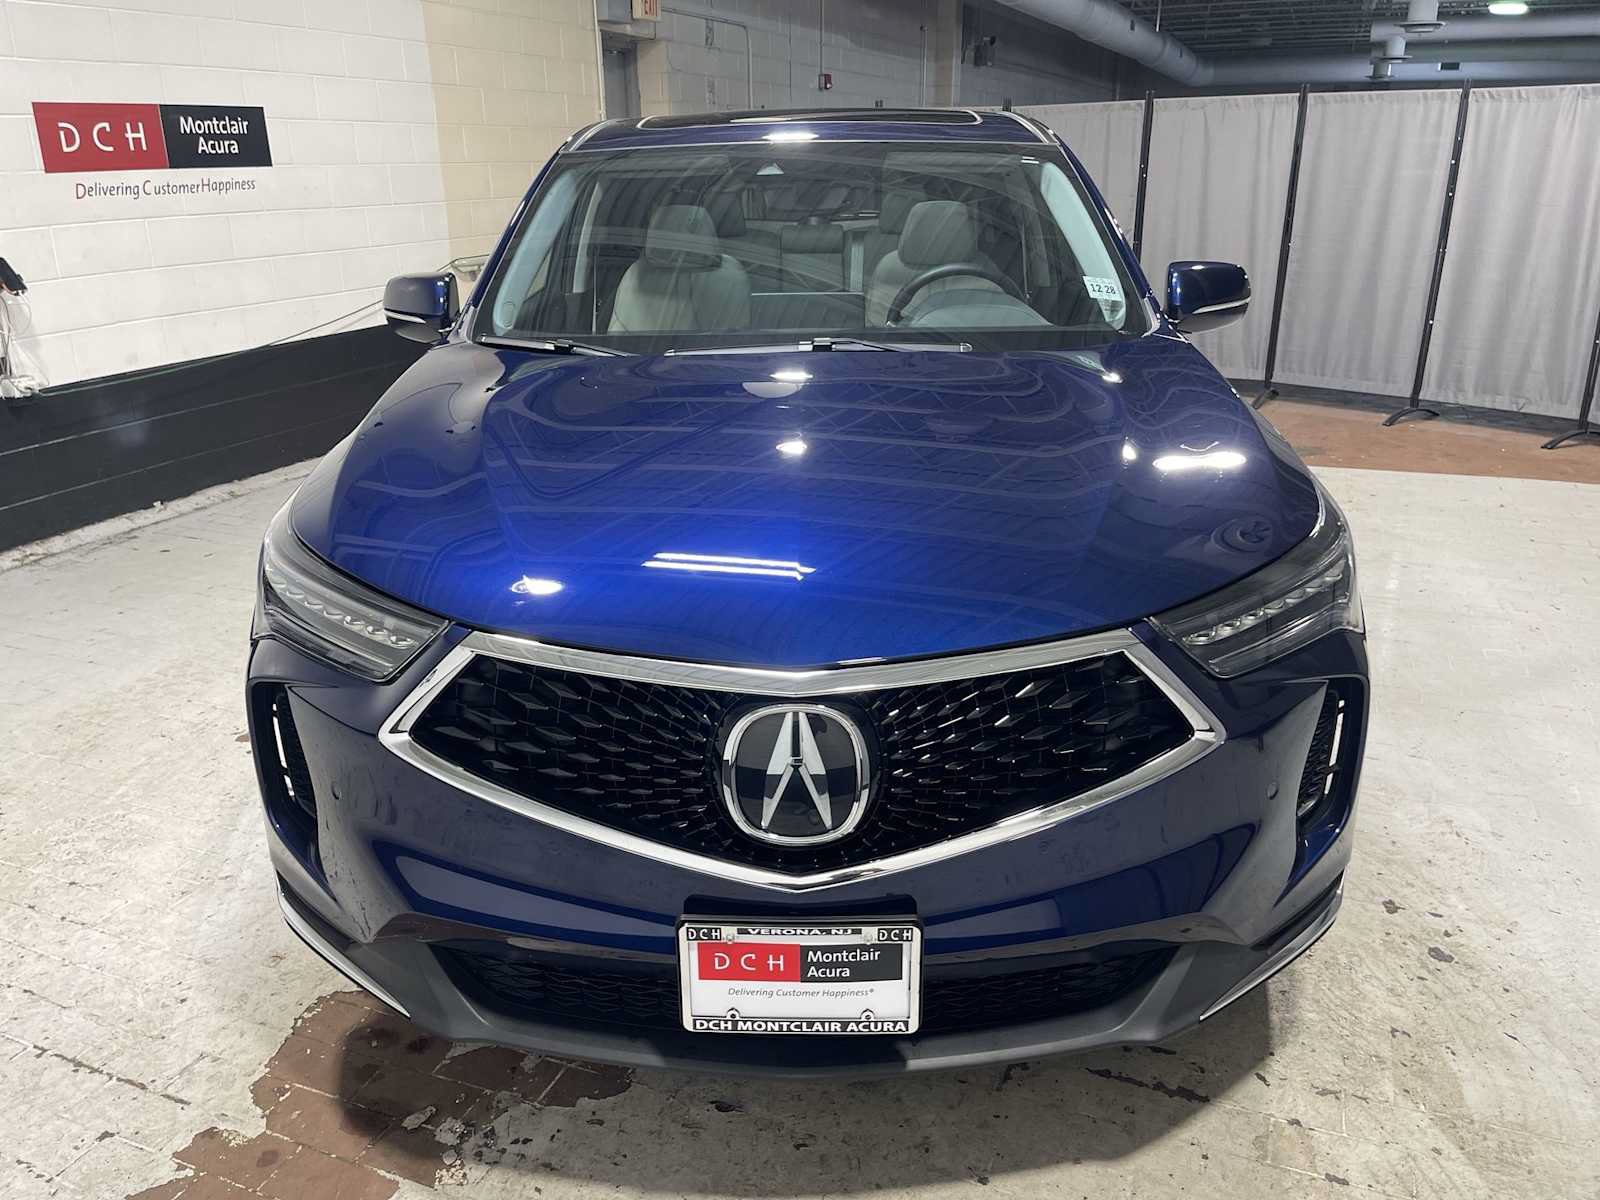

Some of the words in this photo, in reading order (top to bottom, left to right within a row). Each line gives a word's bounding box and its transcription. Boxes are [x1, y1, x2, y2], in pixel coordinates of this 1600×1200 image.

[179, 115, 249, 135] Montclair
[197, 136, 239, 154] Acura
[75, 182, 140, 200] Delivering
[143, 179, 200, 196] Customer
[201, 177, 257, 197] Happiness
[1090, 283, 1102, 293] 12
[688, 928, 720, 940] DCH
[879, 929, 912, 940] DCH
[714, 952, 784, 972] DCH
[807, 948, 880, 963] Montclair
[807, 966, 850, 978] Acura
[728, 987, 774, 999] Delivering
[776, 987, 820, 998] Customer
[695, 1019, 732, 1031] DCH
[737, 1020, 841, 1032] MONTCLAIR
[847, 1021, 906, 1032] ACURA
